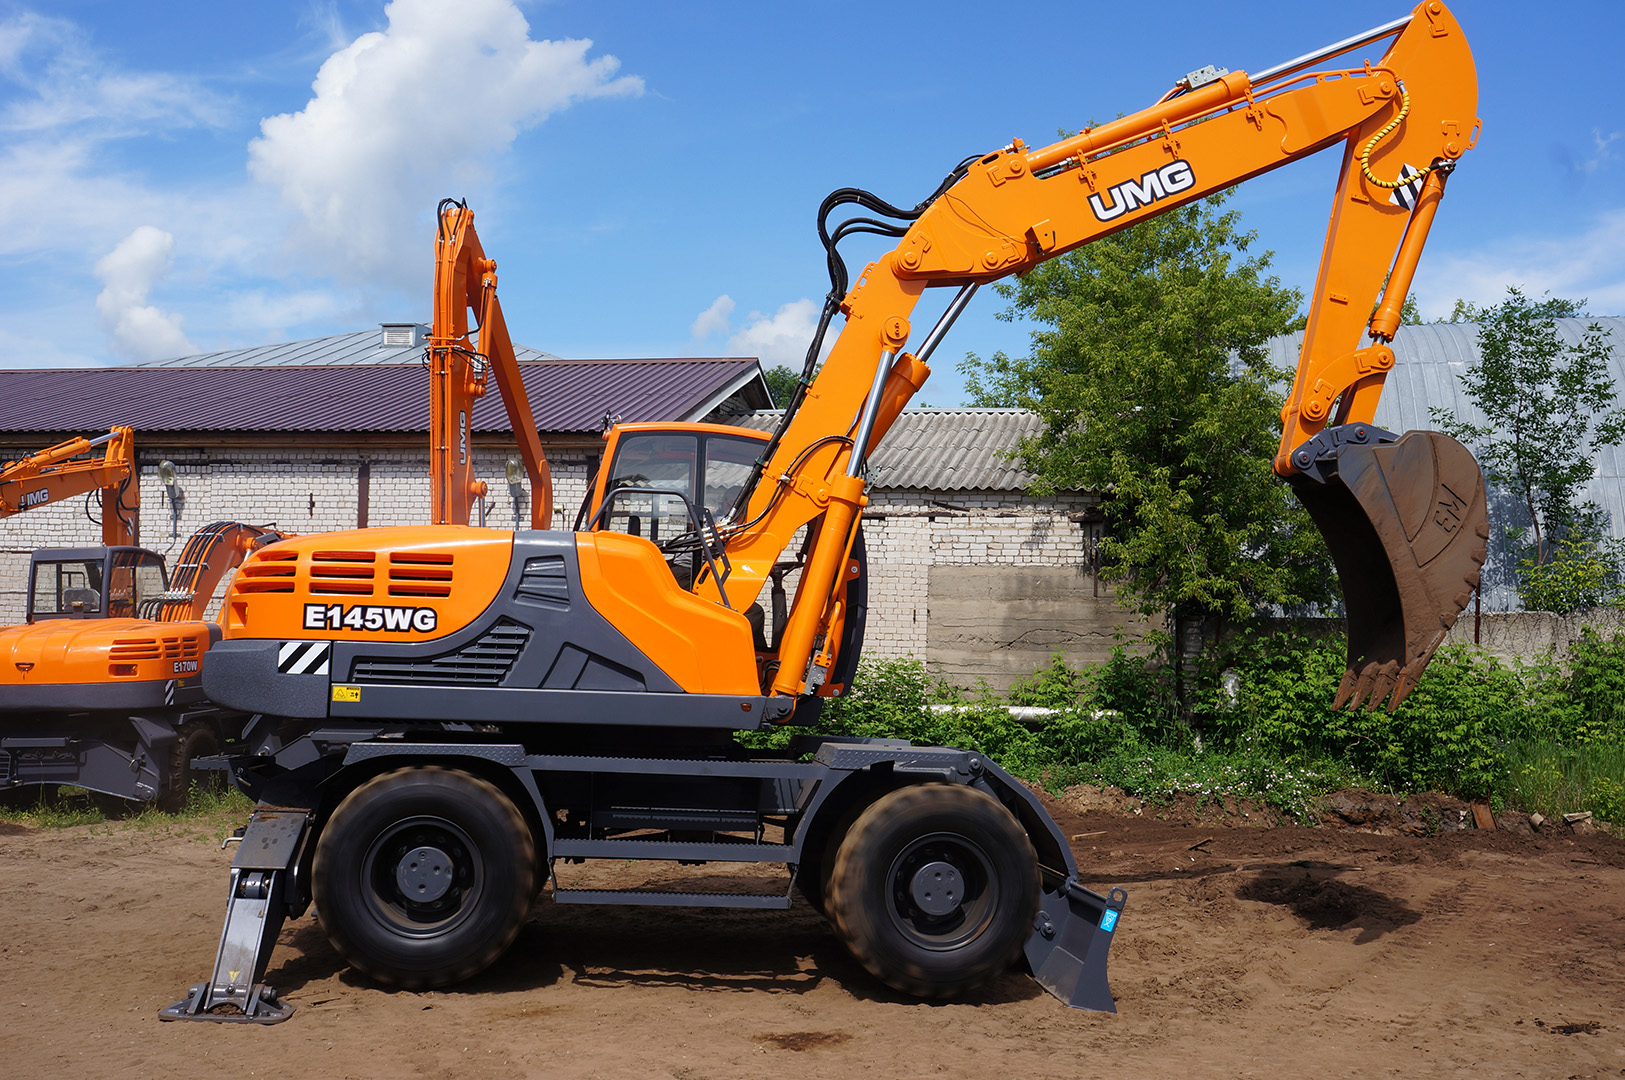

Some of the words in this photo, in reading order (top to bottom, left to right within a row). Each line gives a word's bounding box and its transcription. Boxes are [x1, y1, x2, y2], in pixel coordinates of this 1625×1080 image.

[1086, 159, 1196, 222] UMG
[459, 410, 467, 465] UMG
[303, 603, 437, 632] E145WG
[173, 660, 198, 673] E170W
